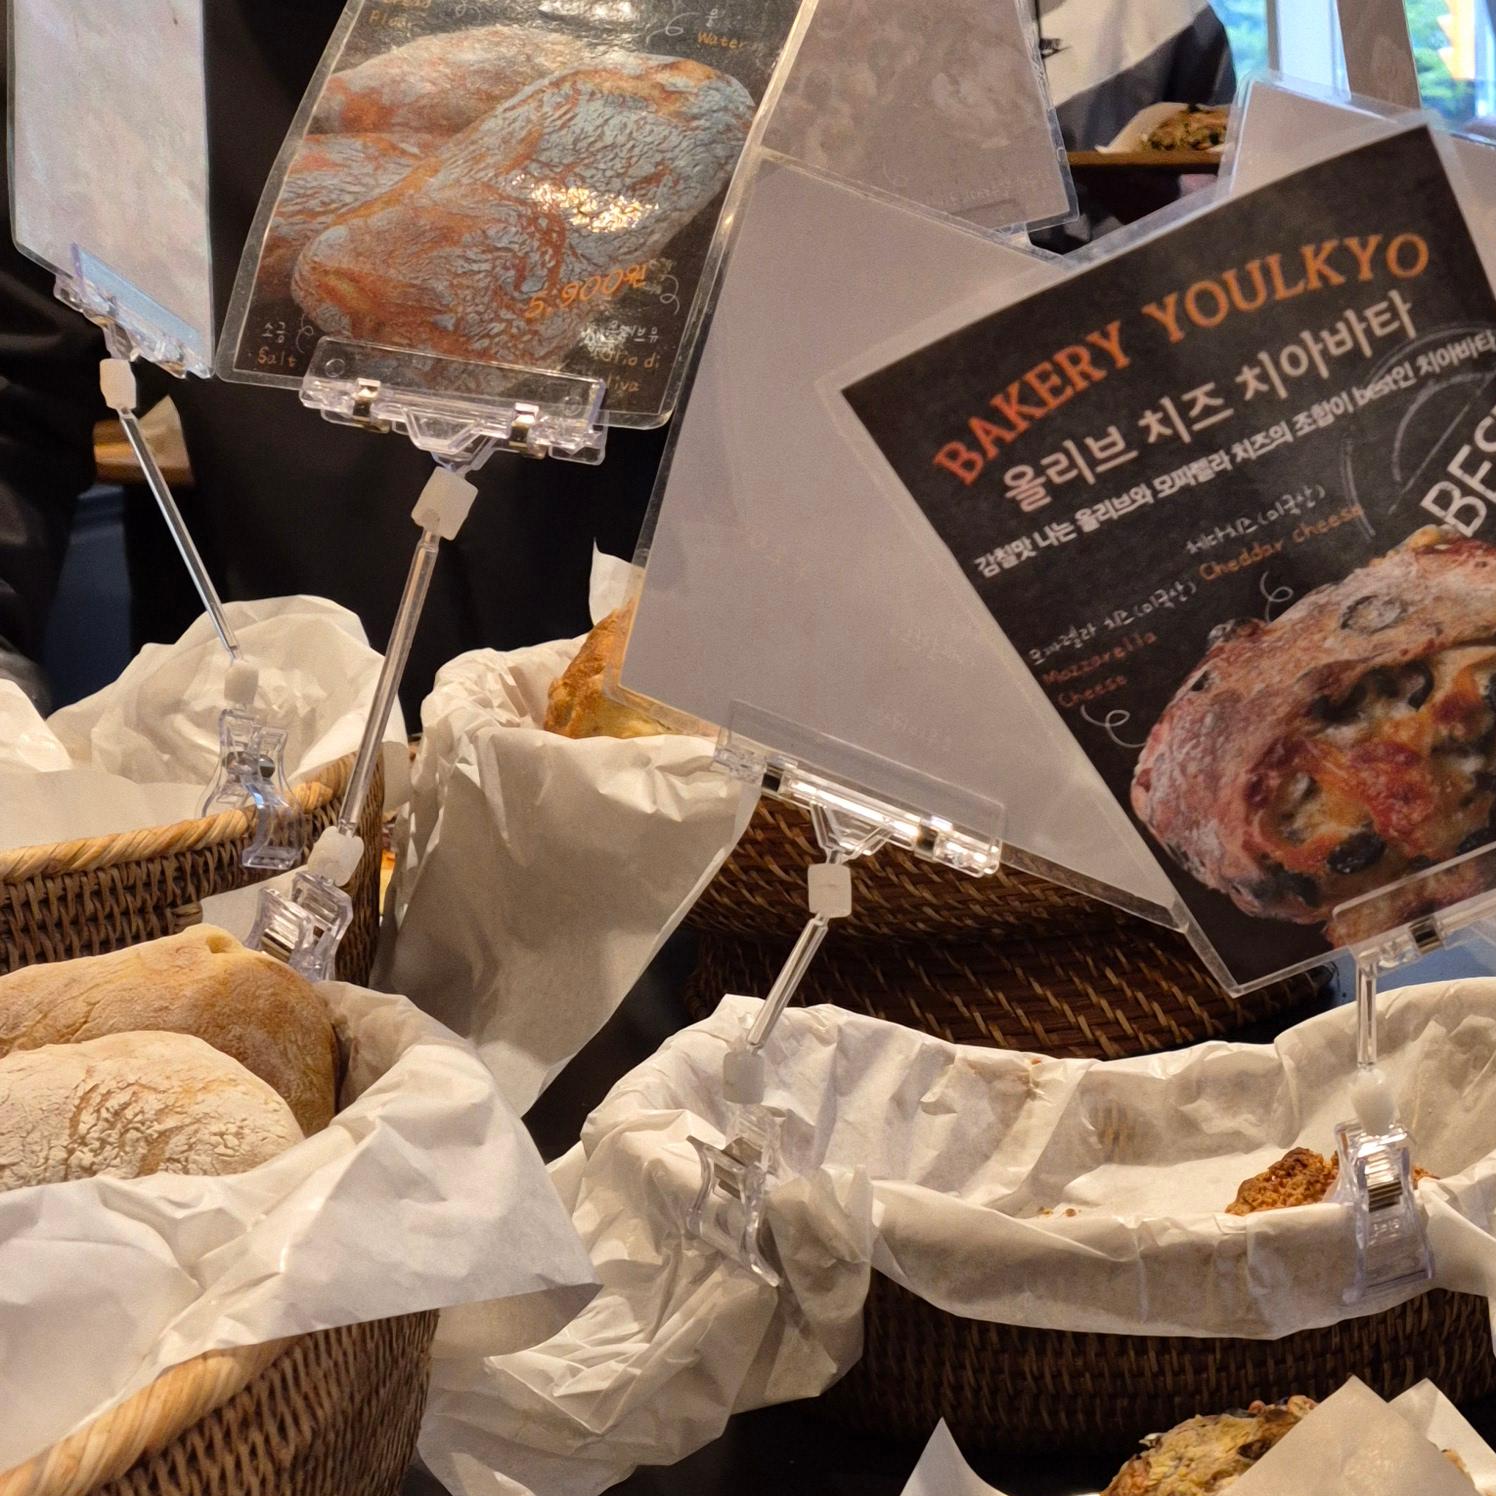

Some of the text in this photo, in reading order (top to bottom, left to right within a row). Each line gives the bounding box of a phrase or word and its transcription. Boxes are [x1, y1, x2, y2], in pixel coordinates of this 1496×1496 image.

[697, 31, 747, 49] Water
[525, 264, 648, 320] 5,900원
[261, 321, 287, 344] 소금
[257, 345, 297, 367] Salt
[643, 350, 660, 368] di
[933, 233, 1429, 486] BAKERY YOULKYO
[606, 372, 641, 392] liva
[1003, 289, 1417, 512] 올리브 치즈 치아바타
[974, 537, 1037, 578] 감칠맛
[1032, 520, 1078, 548] 나는
[1075, 483, 1154, 533] 올리브와
[1231, 421, 1293, 462] 치즈의
[1292, 390, 1354, 437] 조합이
[1352, 361, 1417, 406] best인
[1199, 539, 1285, 580] Cheddar
